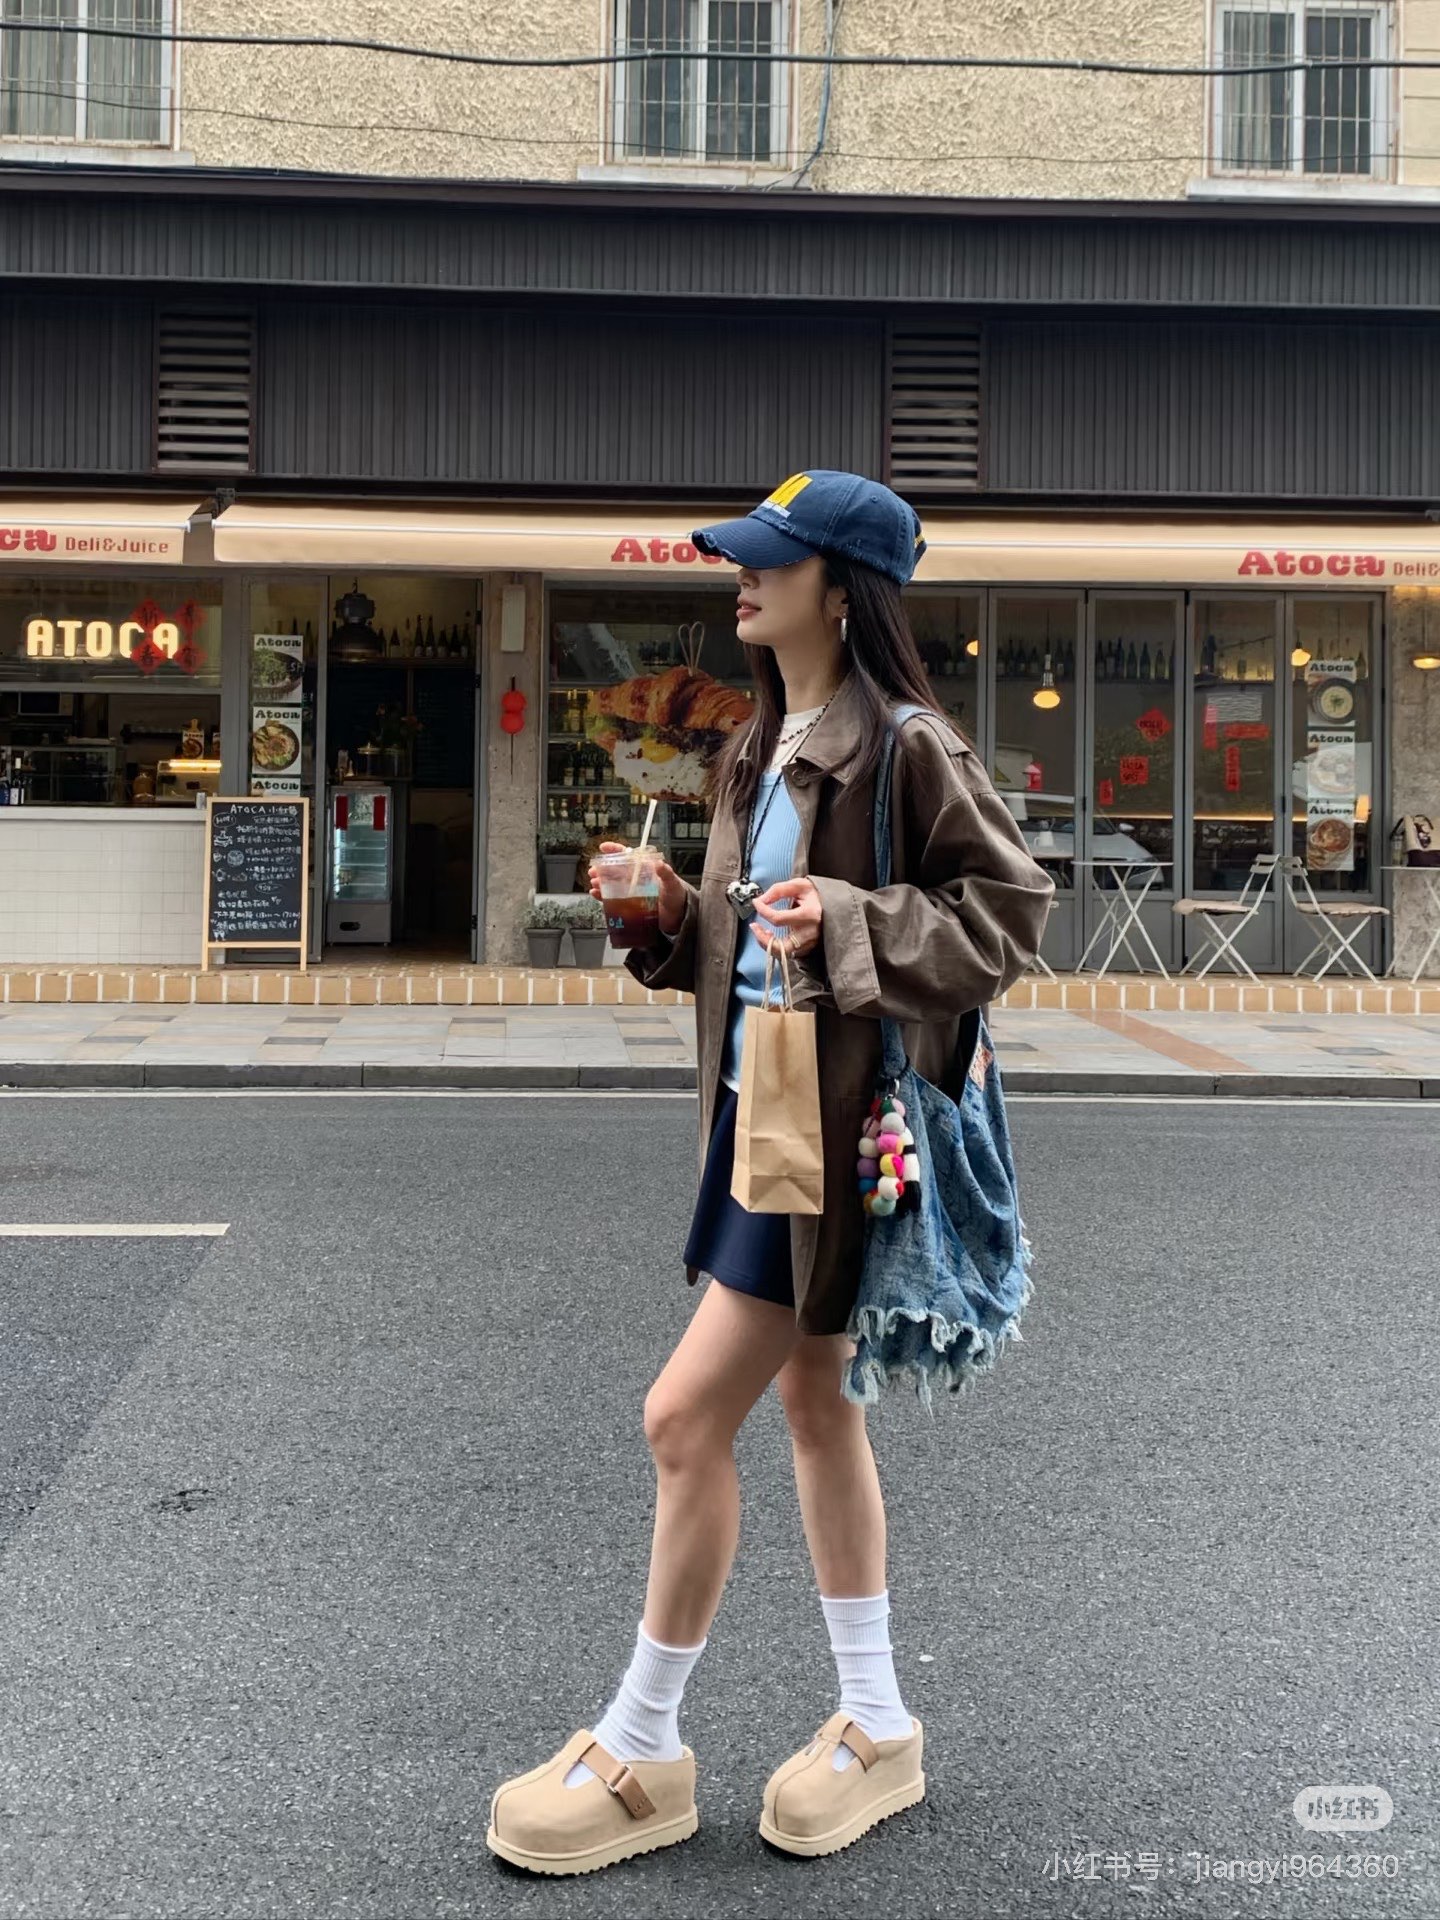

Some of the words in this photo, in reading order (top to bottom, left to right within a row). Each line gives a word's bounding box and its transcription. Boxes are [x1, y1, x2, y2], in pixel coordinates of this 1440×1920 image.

[65, 536, 169, 554] Deli&Juice
[1238, 550, 1385, 577] Atoca
[27, 619, 179, 659] ATOCA
[256, 637, 302, 647] Atoca
[1310, 662, 1354, 672] Atoca
[255, 709, 301, 719] Atoca
[1309, 733, 1354, 743] Atoca
[253, 780, 299, 790] Atoca
[230, 804, 266, 815] ATOCA
